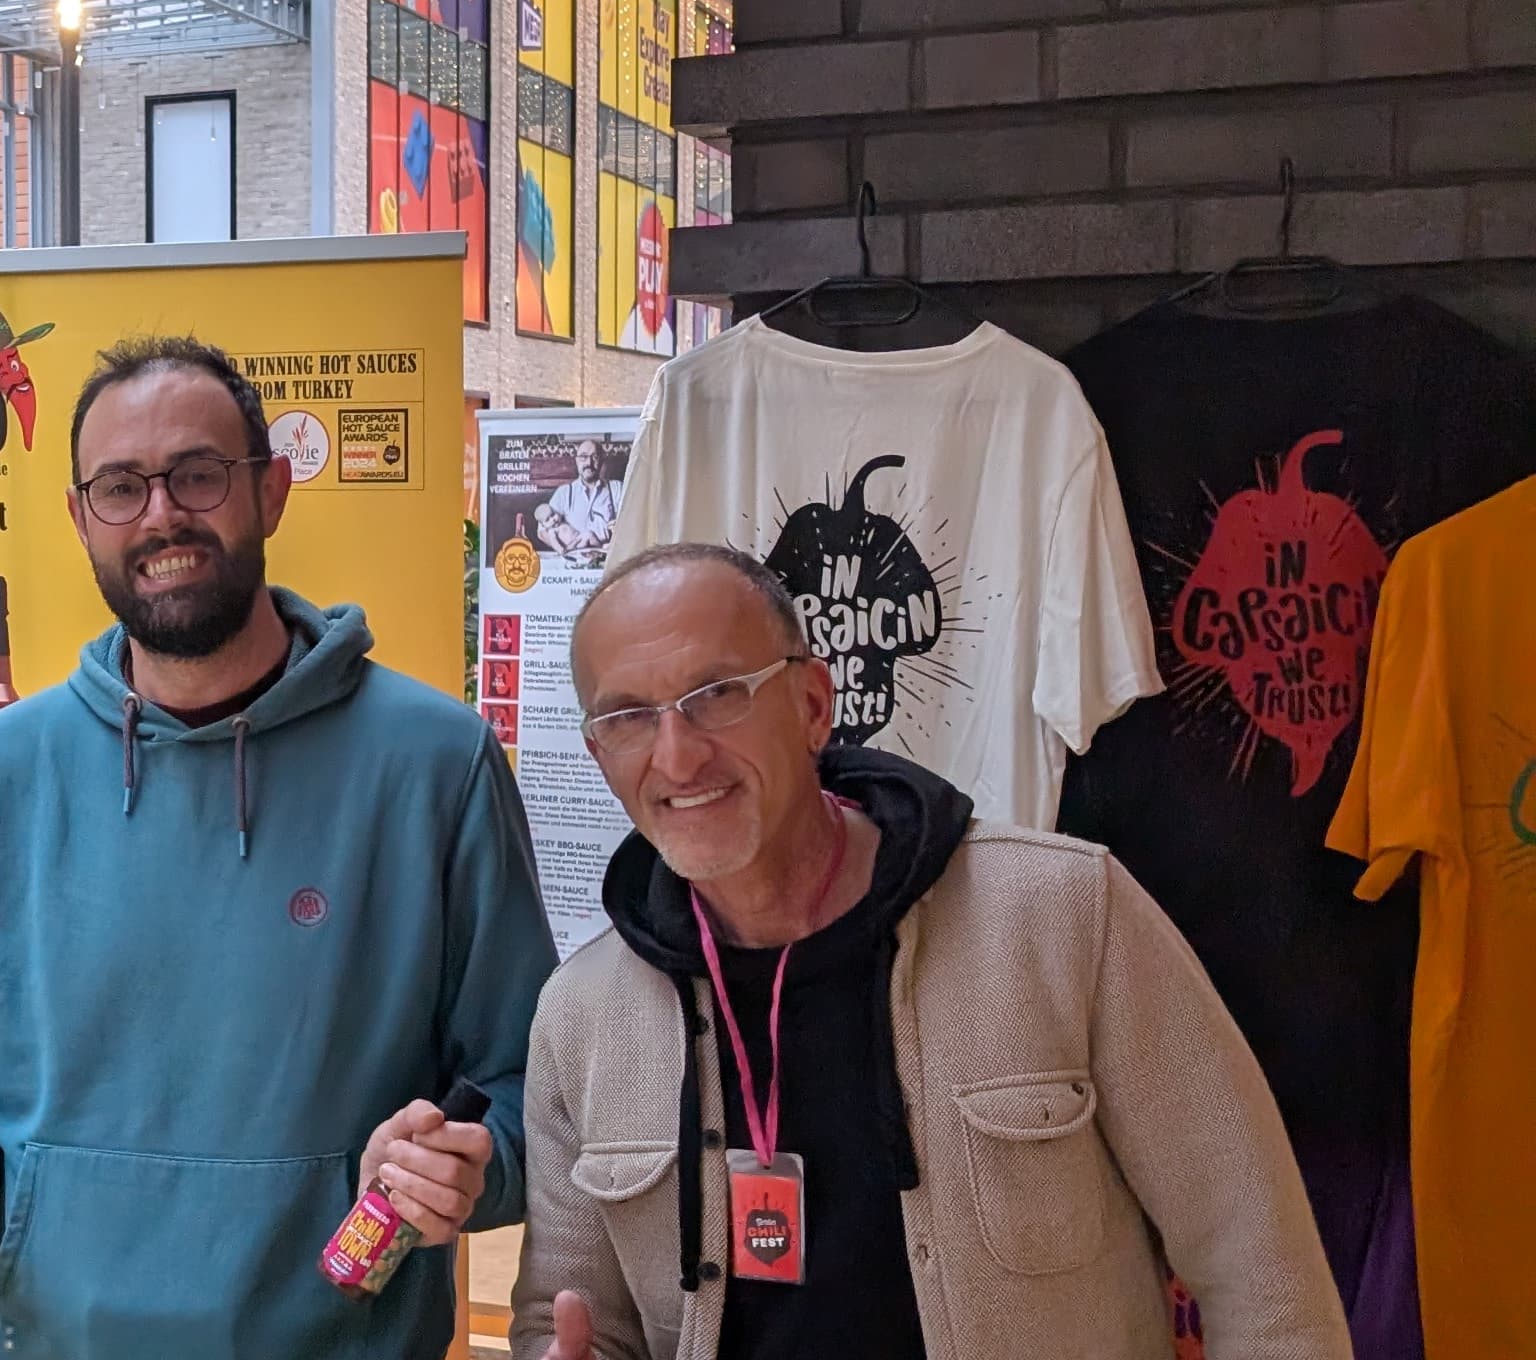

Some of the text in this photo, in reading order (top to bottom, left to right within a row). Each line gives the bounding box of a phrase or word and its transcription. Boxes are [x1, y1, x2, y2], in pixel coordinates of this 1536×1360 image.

[245, 355, 313, 377] WINNING
[319, 354, 351, 375] HOT
[356, 353, 417, 374] SAUCES
[254, 379, 354, 400] ROM TURKEY
[342, 414, 398, 423] EUROPEAN
[342, 423, 400, 432] HOT SAUCE
[343, 433, 388, 442] AWARDS
[506, 439, 524, 449] ZUM
[499, 450, 530, 460] BRATEN
[497, 462, 530, 471] GRILLEN
[497, 473, 530, 482] KOCHEN
[490, 484, 537, 494] VERFEINERN
[542, 576, 572, 585] ECKART
[523, 706, 559, 715] SCHARFE
[557, 841, 602, 852] BBQ-SAUCE
[747, 1226, 787, 1237] CHILI
[751, 1237, 785, 1248] FEST
